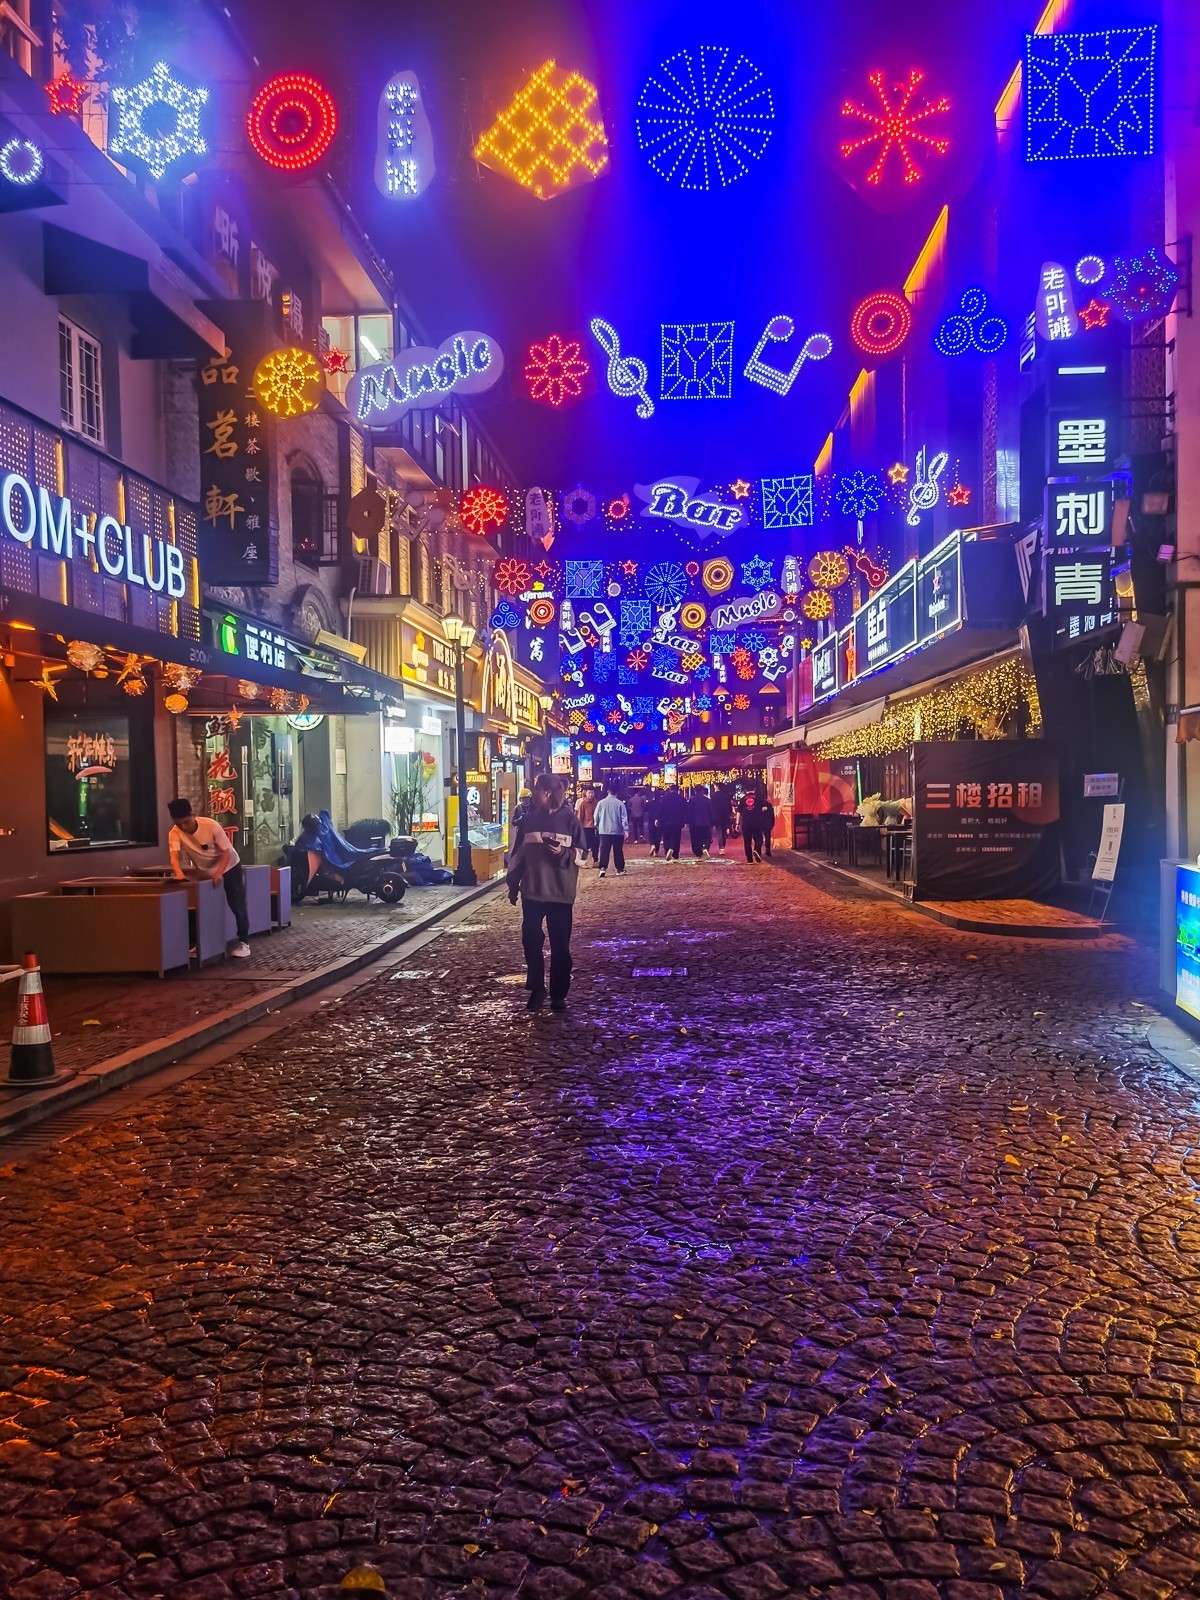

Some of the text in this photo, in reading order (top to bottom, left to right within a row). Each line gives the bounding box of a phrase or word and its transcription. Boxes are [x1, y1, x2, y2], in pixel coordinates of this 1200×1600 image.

[1042, 267, 1072, 341] 老外滩
[357, 336, 492, 419] Music
[648, 483, 743, 531] Bar
[1053, 366, 1107, 607] 一墨刺青
[519, 590, 555, 602] Corona
[716, 591, 778, 629] Music
[925, 782, 1043, 808] 三楼招租
